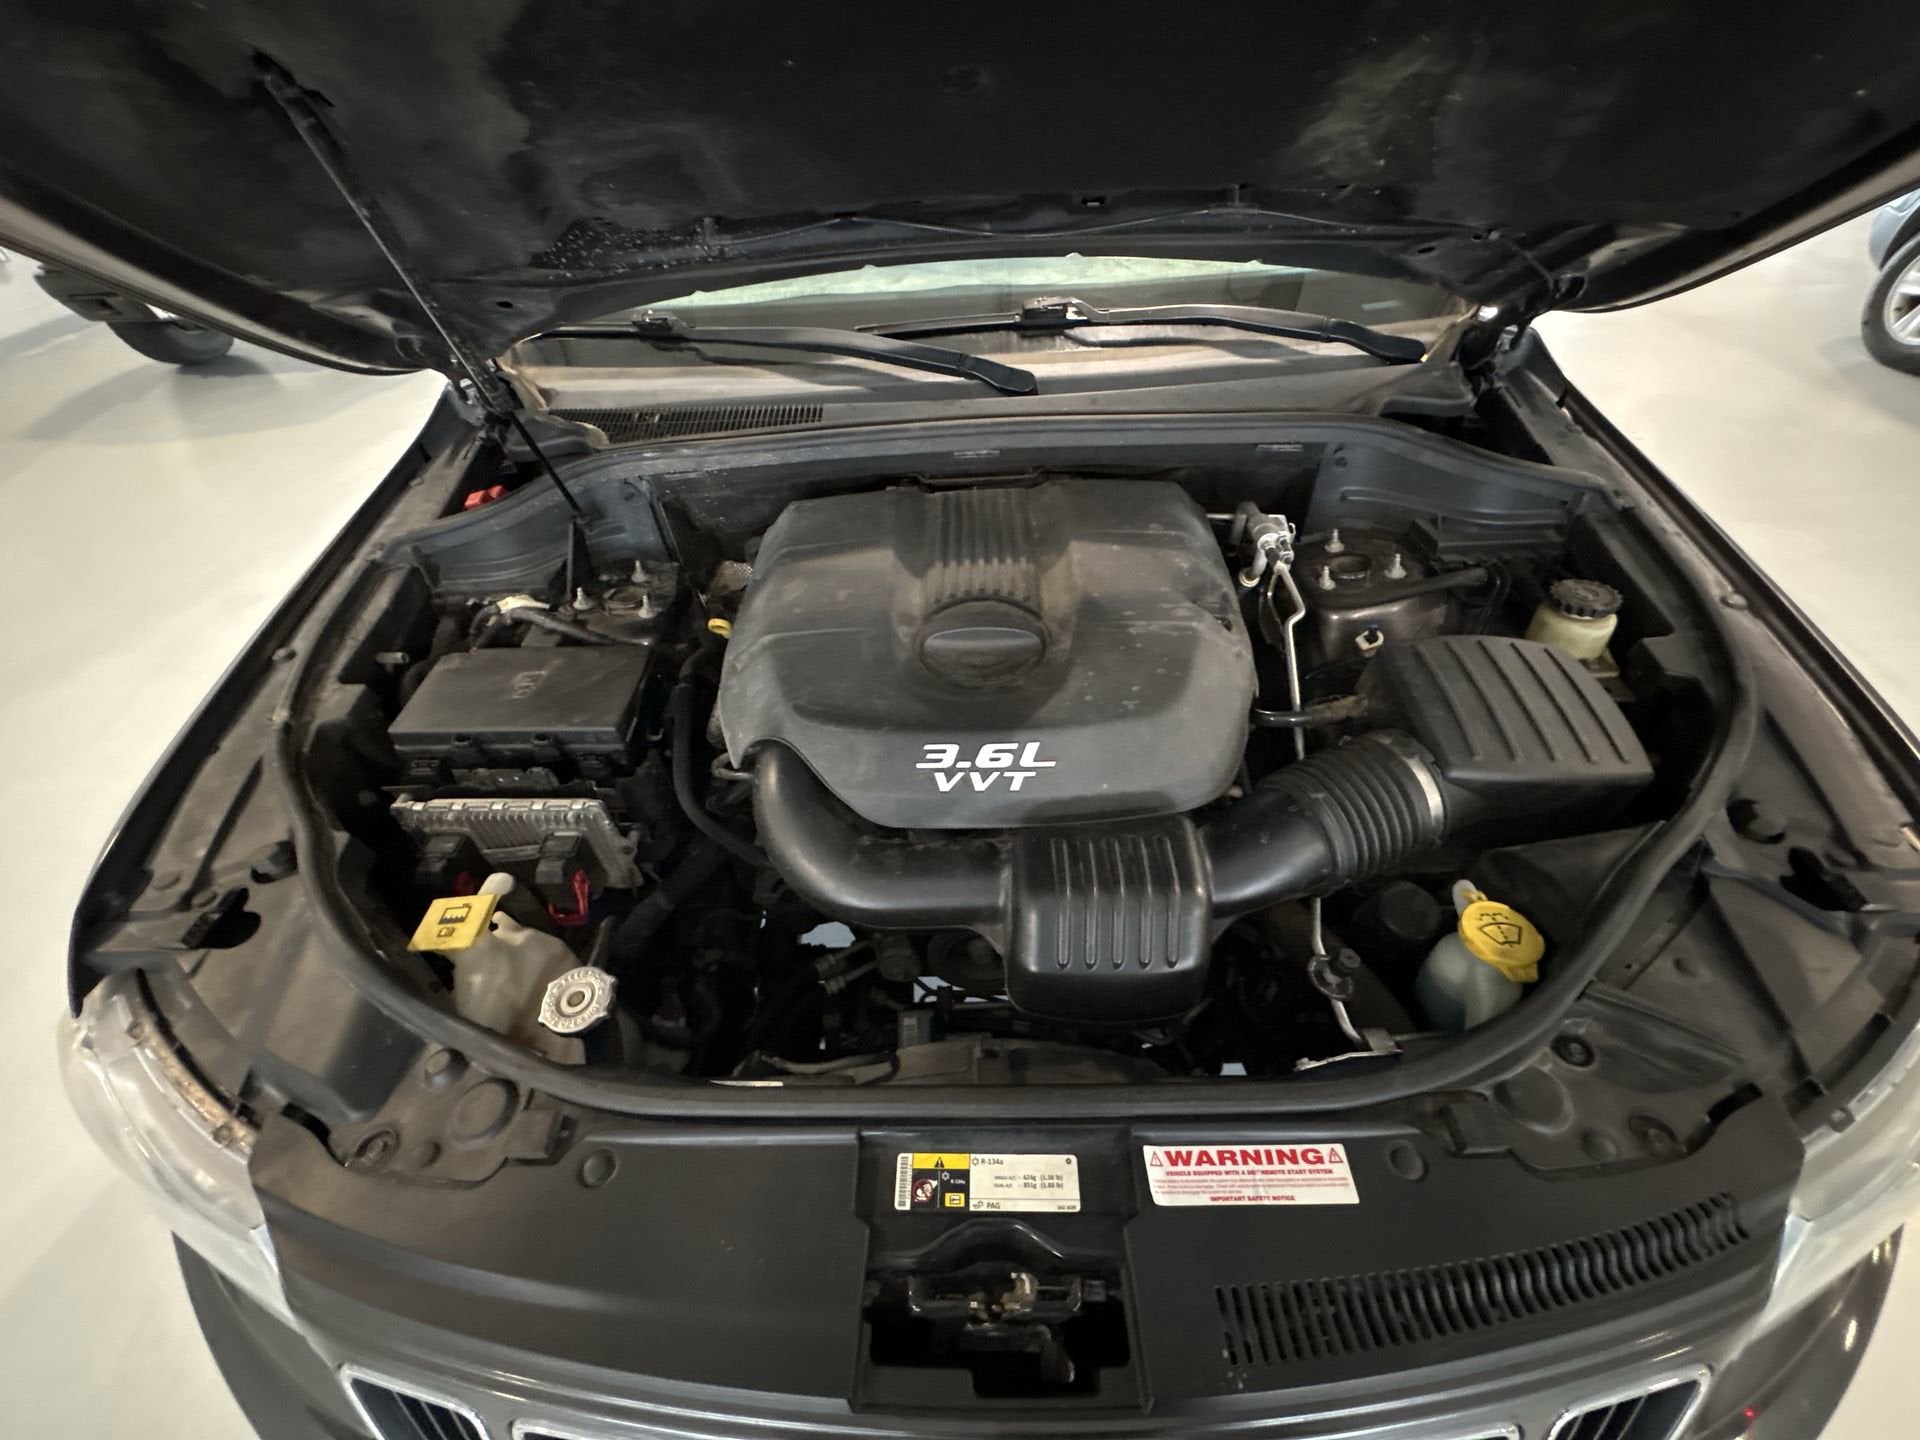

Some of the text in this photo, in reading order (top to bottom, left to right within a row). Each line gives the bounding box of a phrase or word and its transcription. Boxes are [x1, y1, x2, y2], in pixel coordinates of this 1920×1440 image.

[915, 741, 1057, 769] 3.6L
[934, 771, 1037, 792] VVT
[980, 1158, 1004, 1166] R-134a
[1163, 1148, 1325, 1167] WARNING
